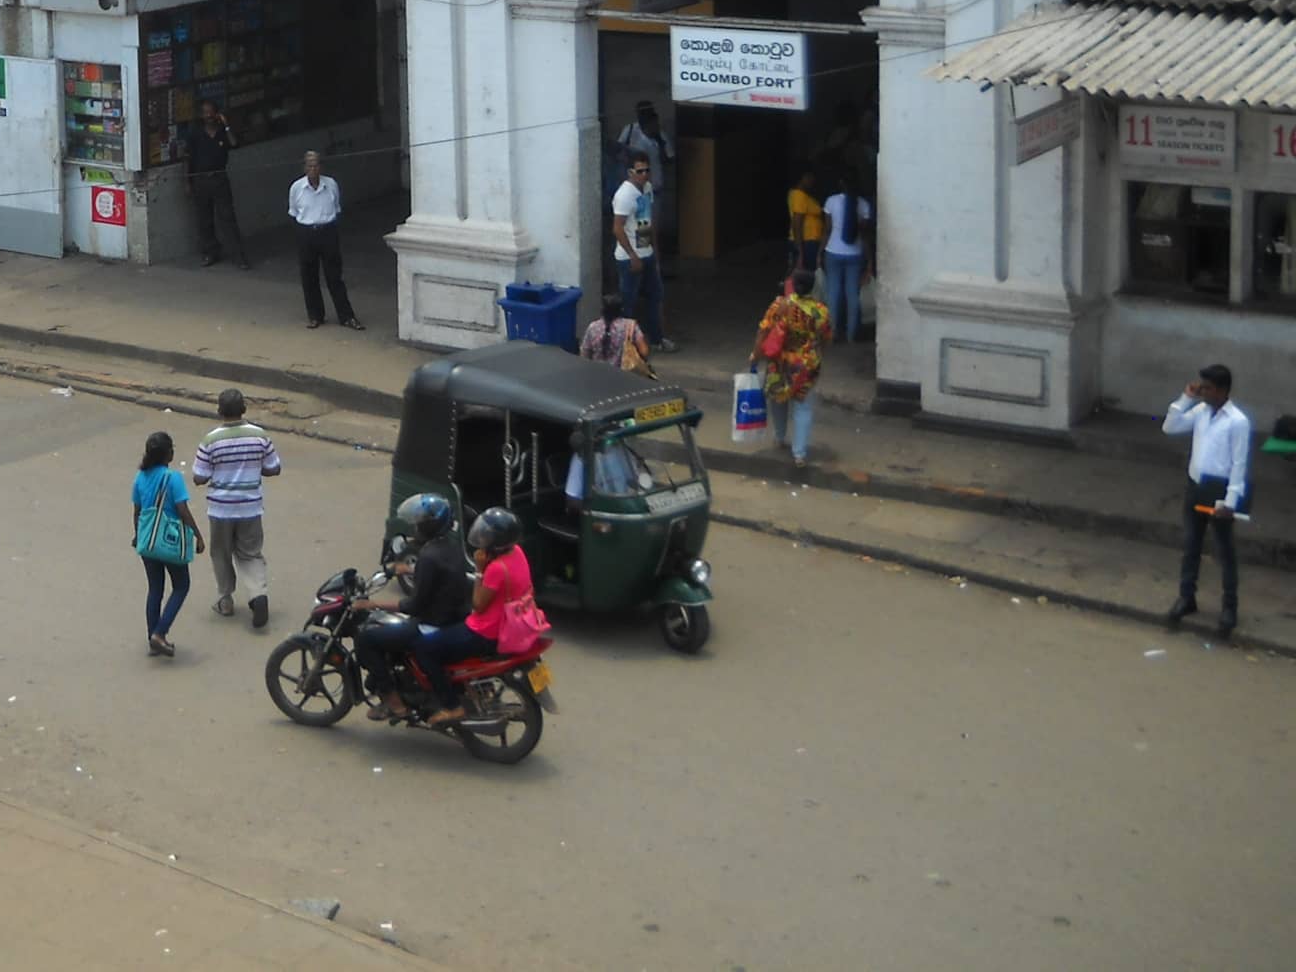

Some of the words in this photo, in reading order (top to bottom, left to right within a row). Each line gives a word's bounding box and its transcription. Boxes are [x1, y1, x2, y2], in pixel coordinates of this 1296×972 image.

[680, 38, 734, 55] කොළඹ
[740, 42, 795, 60] කොටුව
[680, 71, 751, 86] COLOMBO
[755, 76, 795, 89] FORT
[1125, 115, 1153, 147] 11
[1157, 139, 1190, 151] SEASON
[1192, 142, 1225, 153] TICKETS
